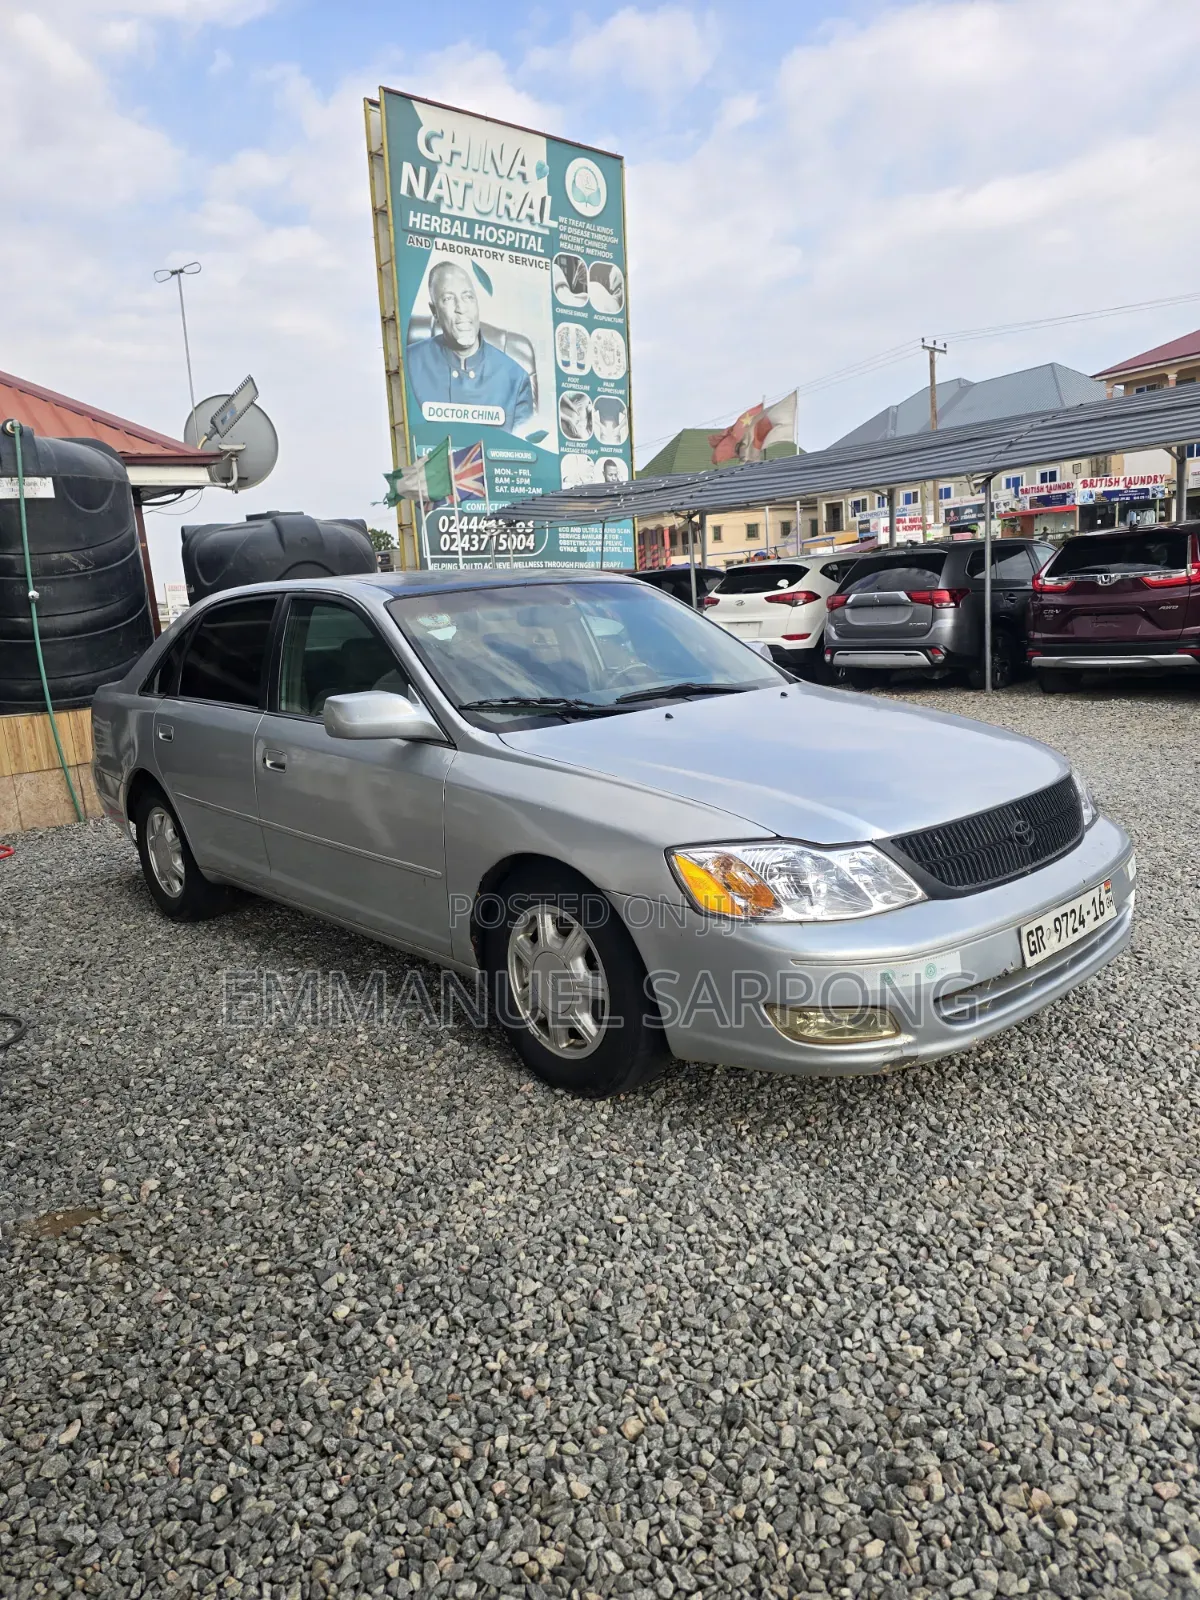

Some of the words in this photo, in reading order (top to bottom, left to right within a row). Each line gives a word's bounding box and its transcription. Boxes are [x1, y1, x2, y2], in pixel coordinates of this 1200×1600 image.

[417, 125, 530, 183] CHINA
[400, 161, 559, 228] NATURAL
[408, 211, 470, 238] HERBAL
[473, 224, 545, 253] HOSPITAL
[559, 216, 568, 224] WE
[569, 218, 585, 229] TREAT
[586, 223, 596, 232] ALL
[597, 226, 614, 235] KINDS
[559, 233, 584, 244] ANCIENT
[584, 239, 607, 250] CHINESE
[568, 227, 590, 238] DISEASE
[591, 233, 618, 244] THROUGH
[406, 235, 431, 249] AND
[434, 241, 504, 262] LABORATORY
[508, 254, 551, 271] SERVICE
[560, 241, 584, 253] HEALING
[586, 247, 613, 259] METHODS
[428, 407, 469, 419] DOCTOR
[471, 410, 500, 421] CHINA
[490, 450, 514, 458] WORKING
[519, 469, 532, 477] FRI.
[1080, 477, 1120, 488] BRITISH
[1123, 474, 1166, 489] LAUNDRY
[1020, 486, 1045, 495] BRITISH
[1046, 482, 1075, 493] LAUNDRY
[574, 561, 595, 569] FINGER
[1026, 925, 1047, 957] GR
[1053, 891, 1105, 943] 9724-16
